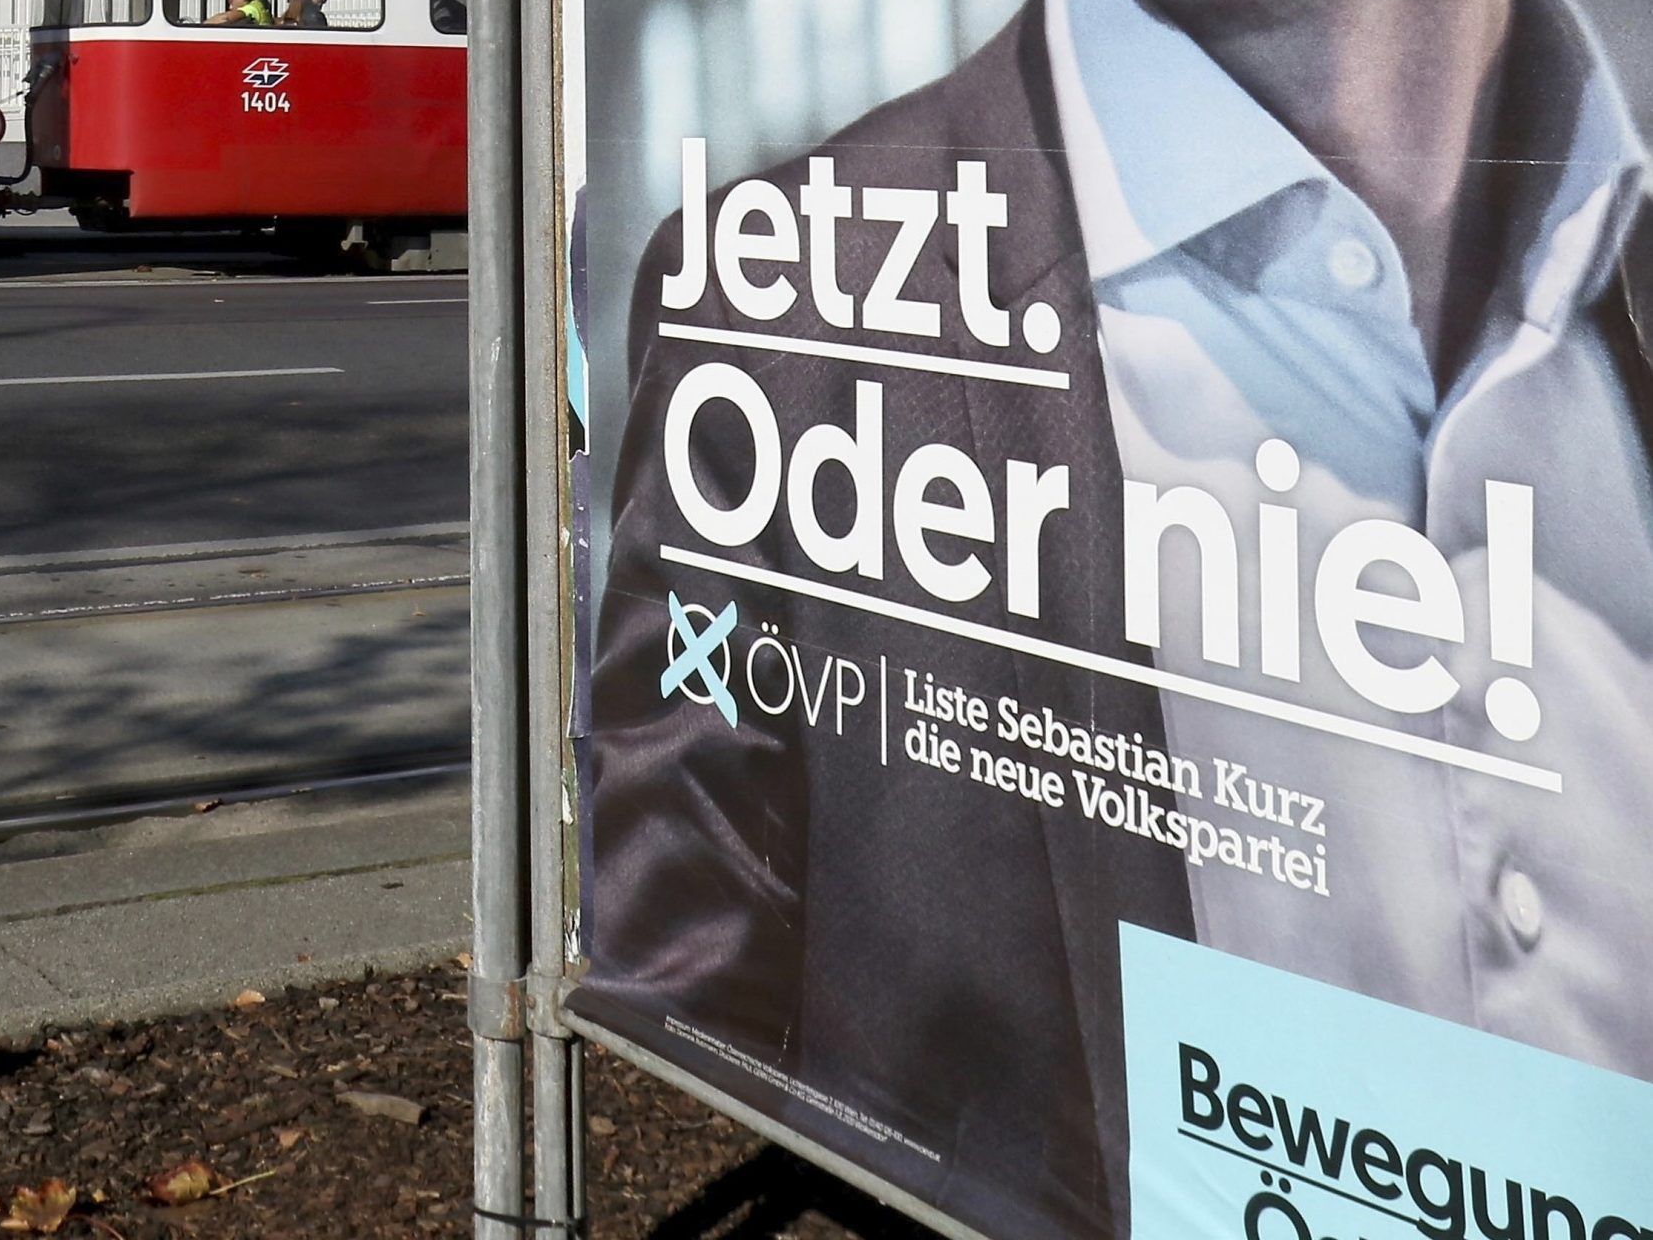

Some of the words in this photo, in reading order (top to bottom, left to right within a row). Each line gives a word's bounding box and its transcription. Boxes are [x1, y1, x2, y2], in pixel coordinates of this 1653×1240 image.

[241, 91, 291, 113] 1404
[661, 137, 1061, 354] Jetzt.
[663, 361, 1070, 619] Oder
[1123, 438, 1541, 742] nie!
[746, 622, 866, 736] ÖVP
[904, 667, 988, 733] Liste
[997, 696, 1203, 800] Sebastian
[1213, 756, 1326, 837] Kurz
[904, 723, 961, 774] die
[970, 745, 1066, 808] neue
[1071, 769, 1330, 897] Volkspartei
